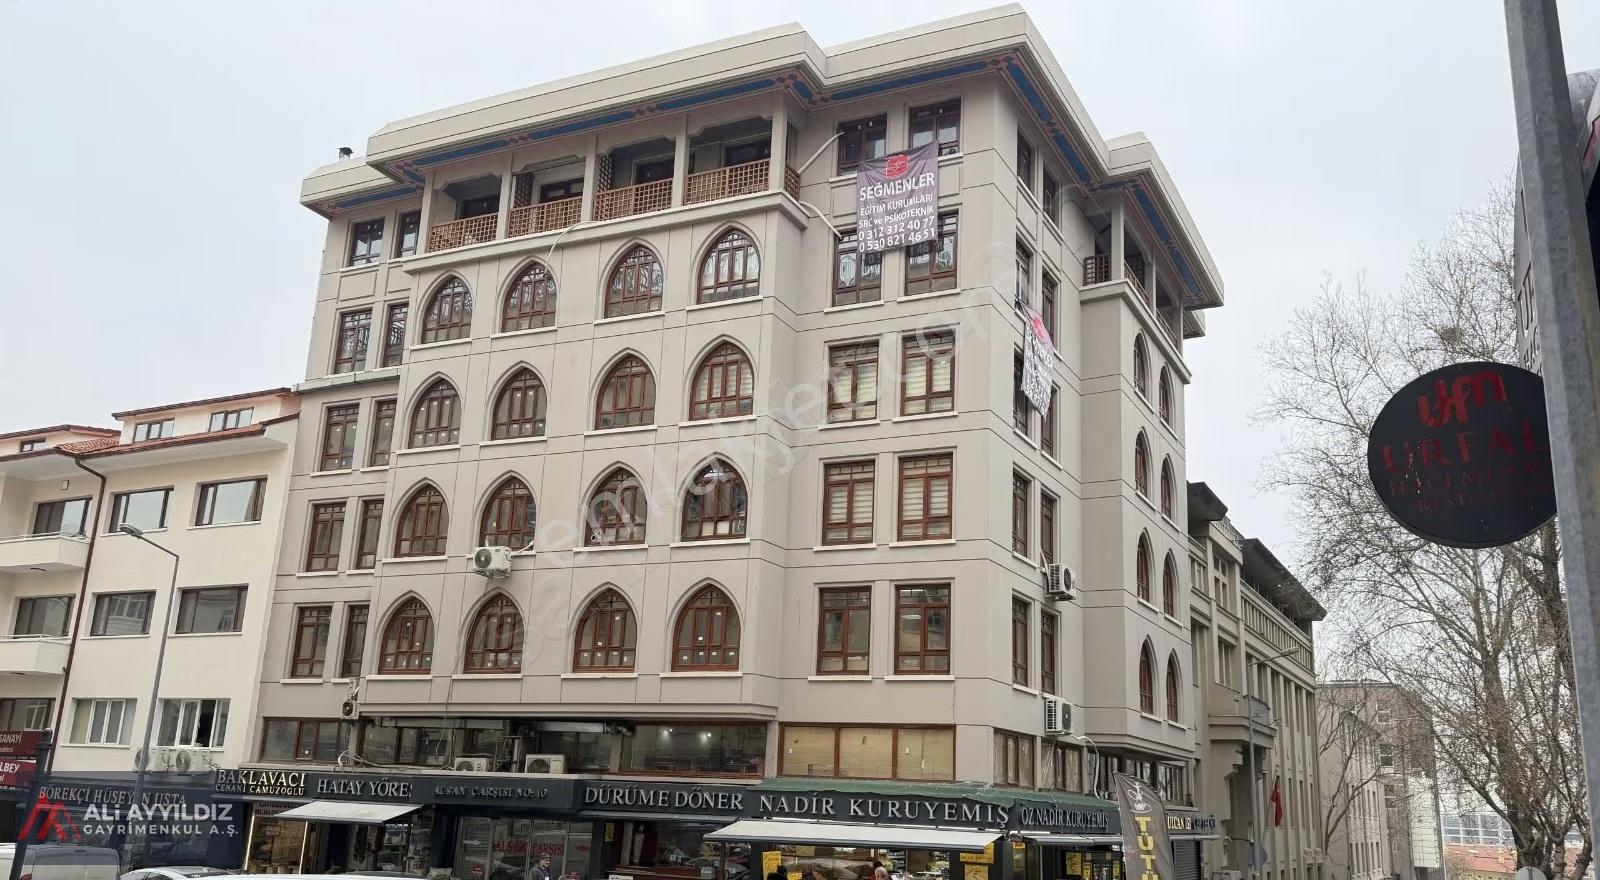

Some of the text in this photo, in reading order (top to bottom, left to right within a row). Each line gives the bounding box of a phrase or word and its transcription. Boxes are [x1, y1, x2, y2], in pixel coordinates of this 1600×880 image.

[859, 172, 935, 201] SEĞMENLER
[860, 193, 934, 216] EĞİTİM KURUMLARI
[884, 204, 935, 224] PSİKOTEKNİK
[859, 215, 935, 240] 0 312 312 40 77
[859, 227, 935, 252] 0 530 821 46 51
[1376, 418, 1548, 476] URFAL
[217, 769, 306, 787] BAKLAVACI
[317, 779, 364, 796] HATAY
[93, 787, 151, 806] HÜSEYN
[585, 784, 744, 810] DÜRÜME DÖNER
[760, 791, 836, 815] NADİR
